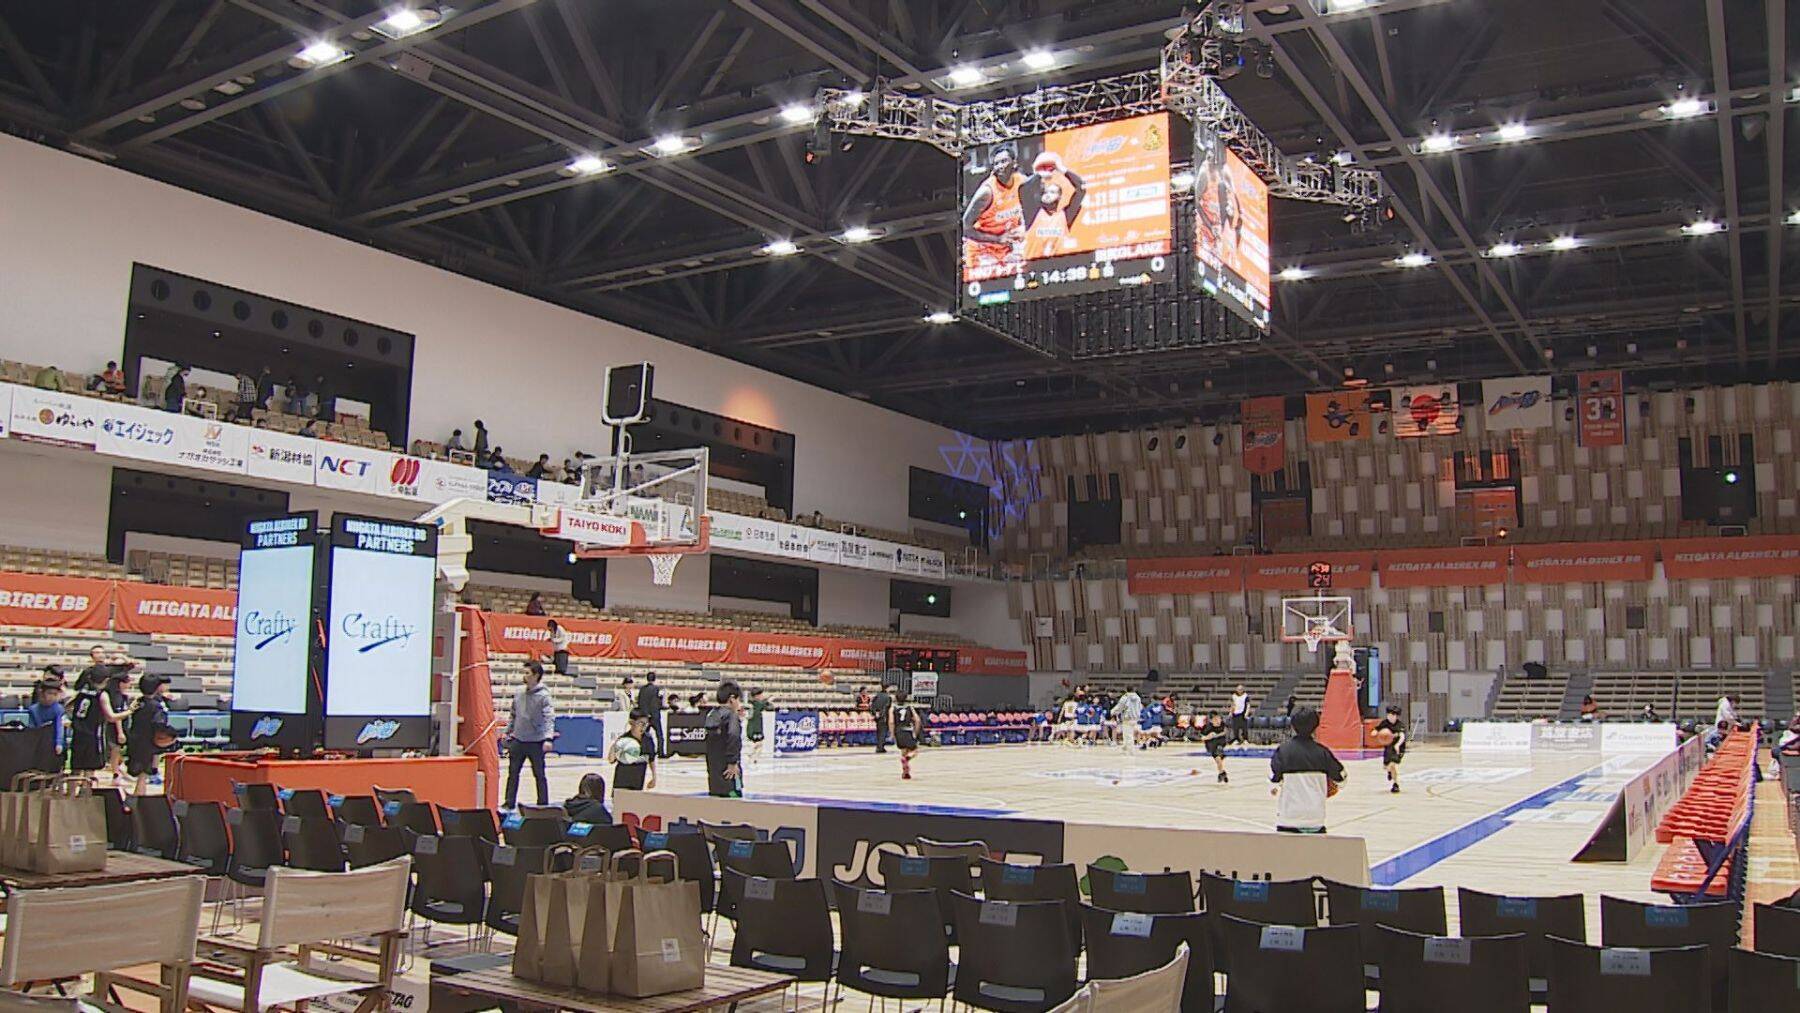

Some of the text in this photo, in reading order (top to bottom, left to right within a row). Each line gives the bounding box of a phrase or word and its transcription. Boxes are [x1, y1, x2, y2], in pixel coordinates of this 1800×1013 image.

[320, 456, 371, 476] NCT
[568, 517, 627, 535] TAIYO KOKI
[257, 531, 298, 547] PARTNERS
[357, 534, 415, 554] PARTNERS
[0, 590, 90, 612] BIREX BB
[138, 599, 210, 619] NIIGATA
[245, 611, 295, 643] Crafty
[342, 612, 415, 647] Crafty
[504, 626, 612, 645] NIIGATA BIREX BB
[637, 635, 728, 652] NIIGATA ALBIREX BB
[683, 728, 706, 739] SoftB
